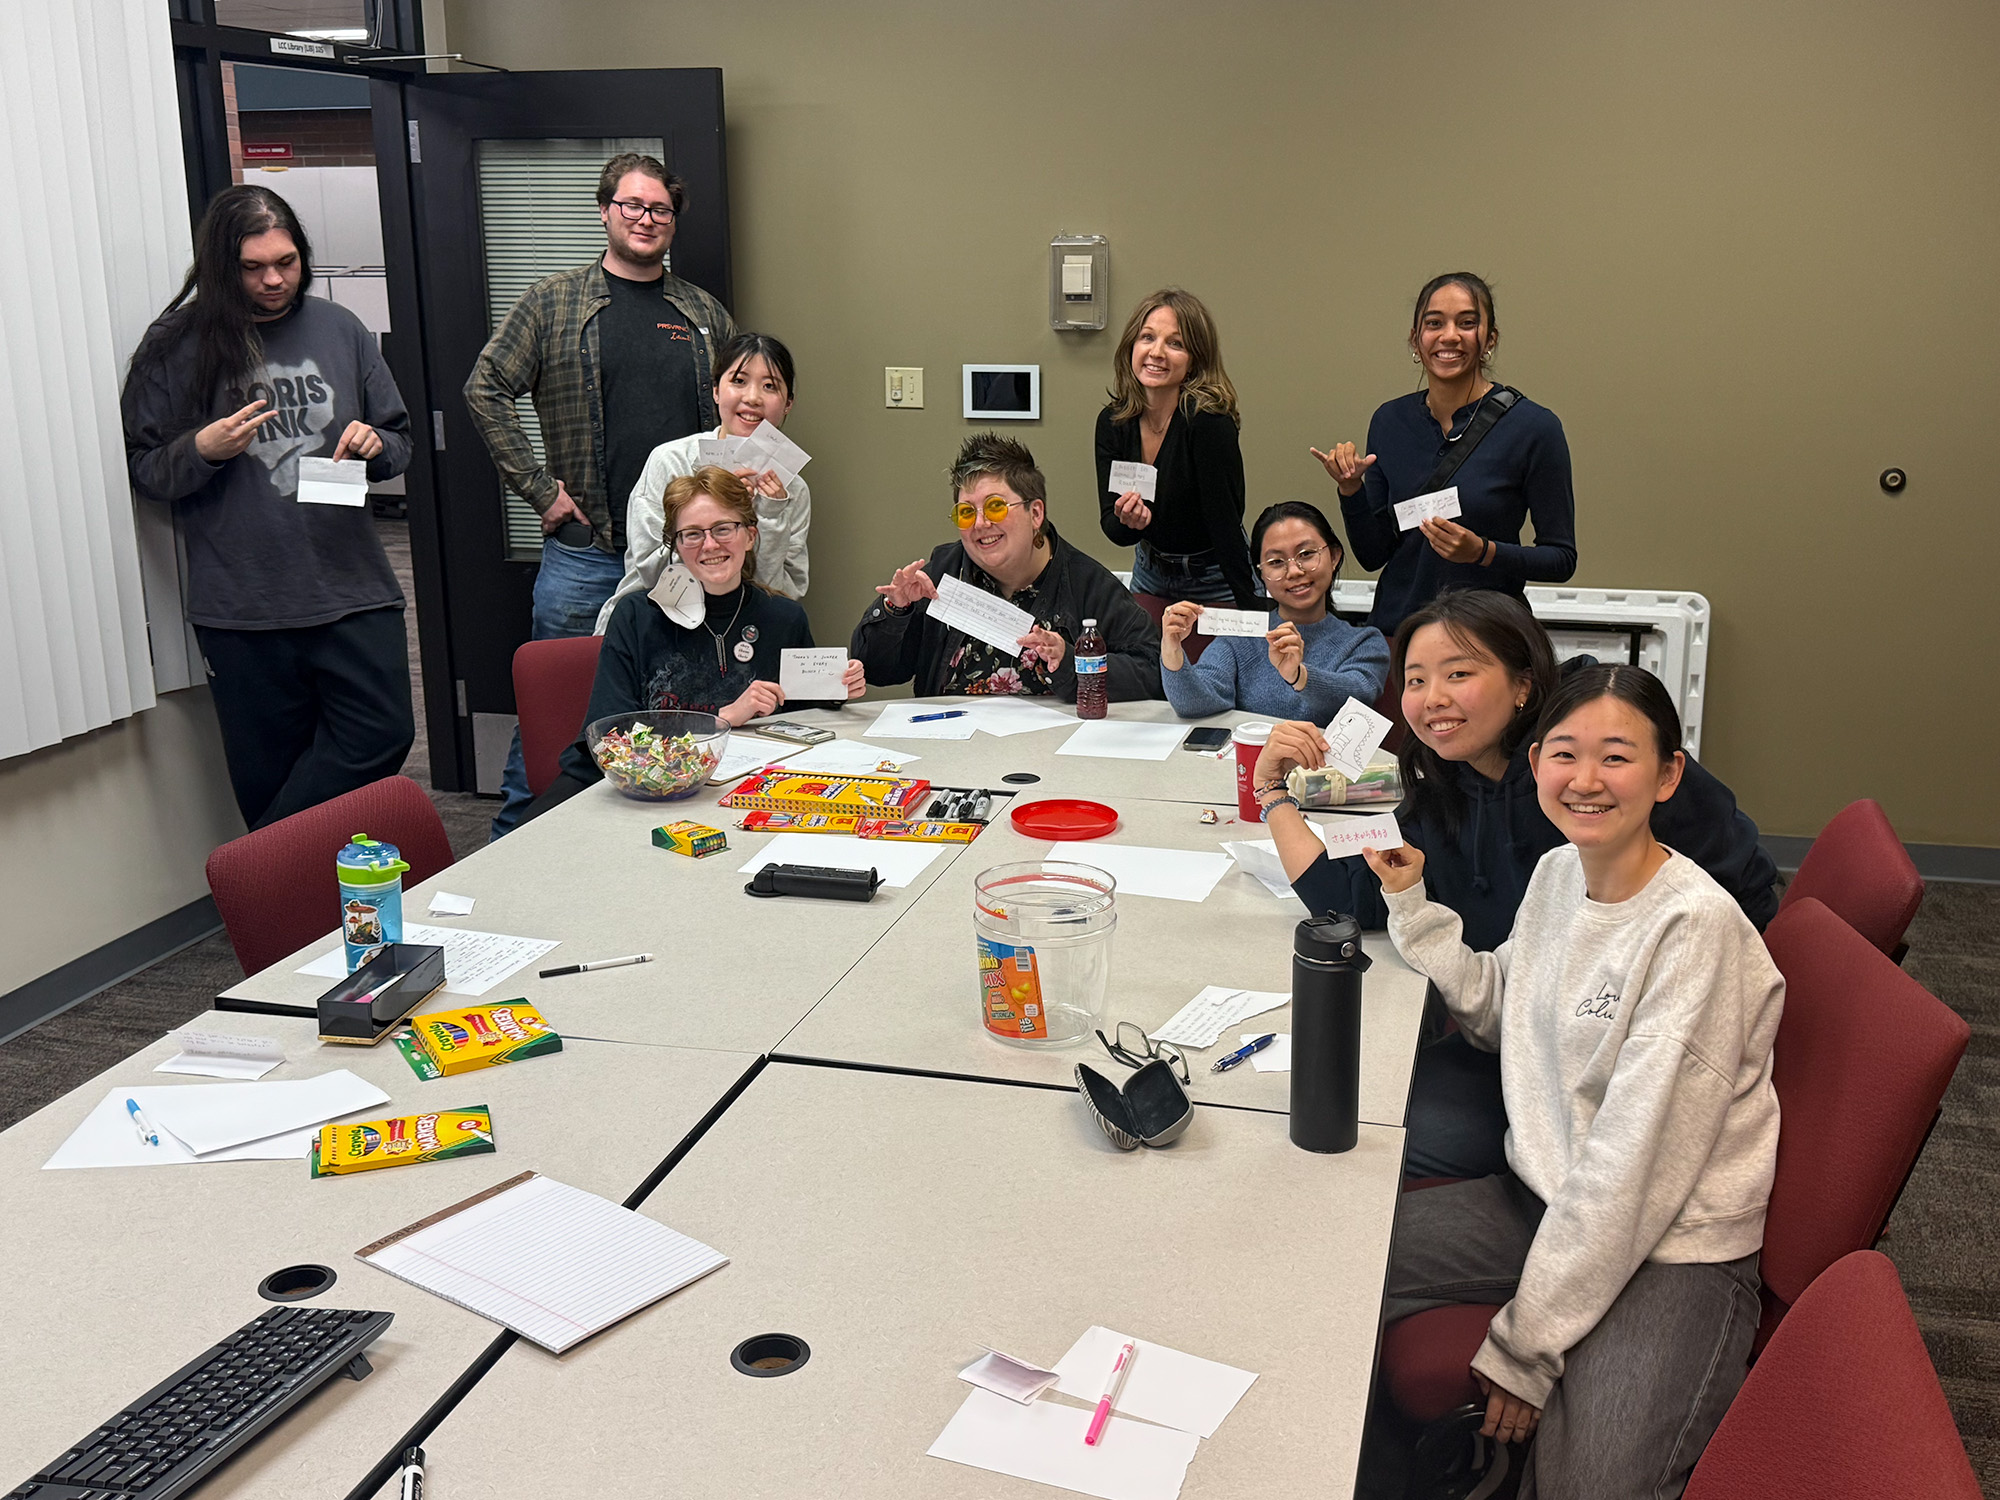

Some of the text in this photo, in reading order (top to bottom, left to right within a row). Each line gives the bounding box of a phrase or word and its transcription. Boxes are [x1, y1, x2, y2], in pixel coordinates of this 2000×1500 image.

[277, 41, 287, 50] LCC
[287, 43, 303, 53] Library
[983, 970, 1007, 988] MIX
[488, 1007, 533, 1041] MARKERS
[428, 1022, 456, 1052] Crayola
[414, 1114, 441, 1151] MARKERS
[461, 1120, 476, 1130] 10
[348, 1127, 363, 1157] Crayola
[378, 1230, 404, 1245] Legal
